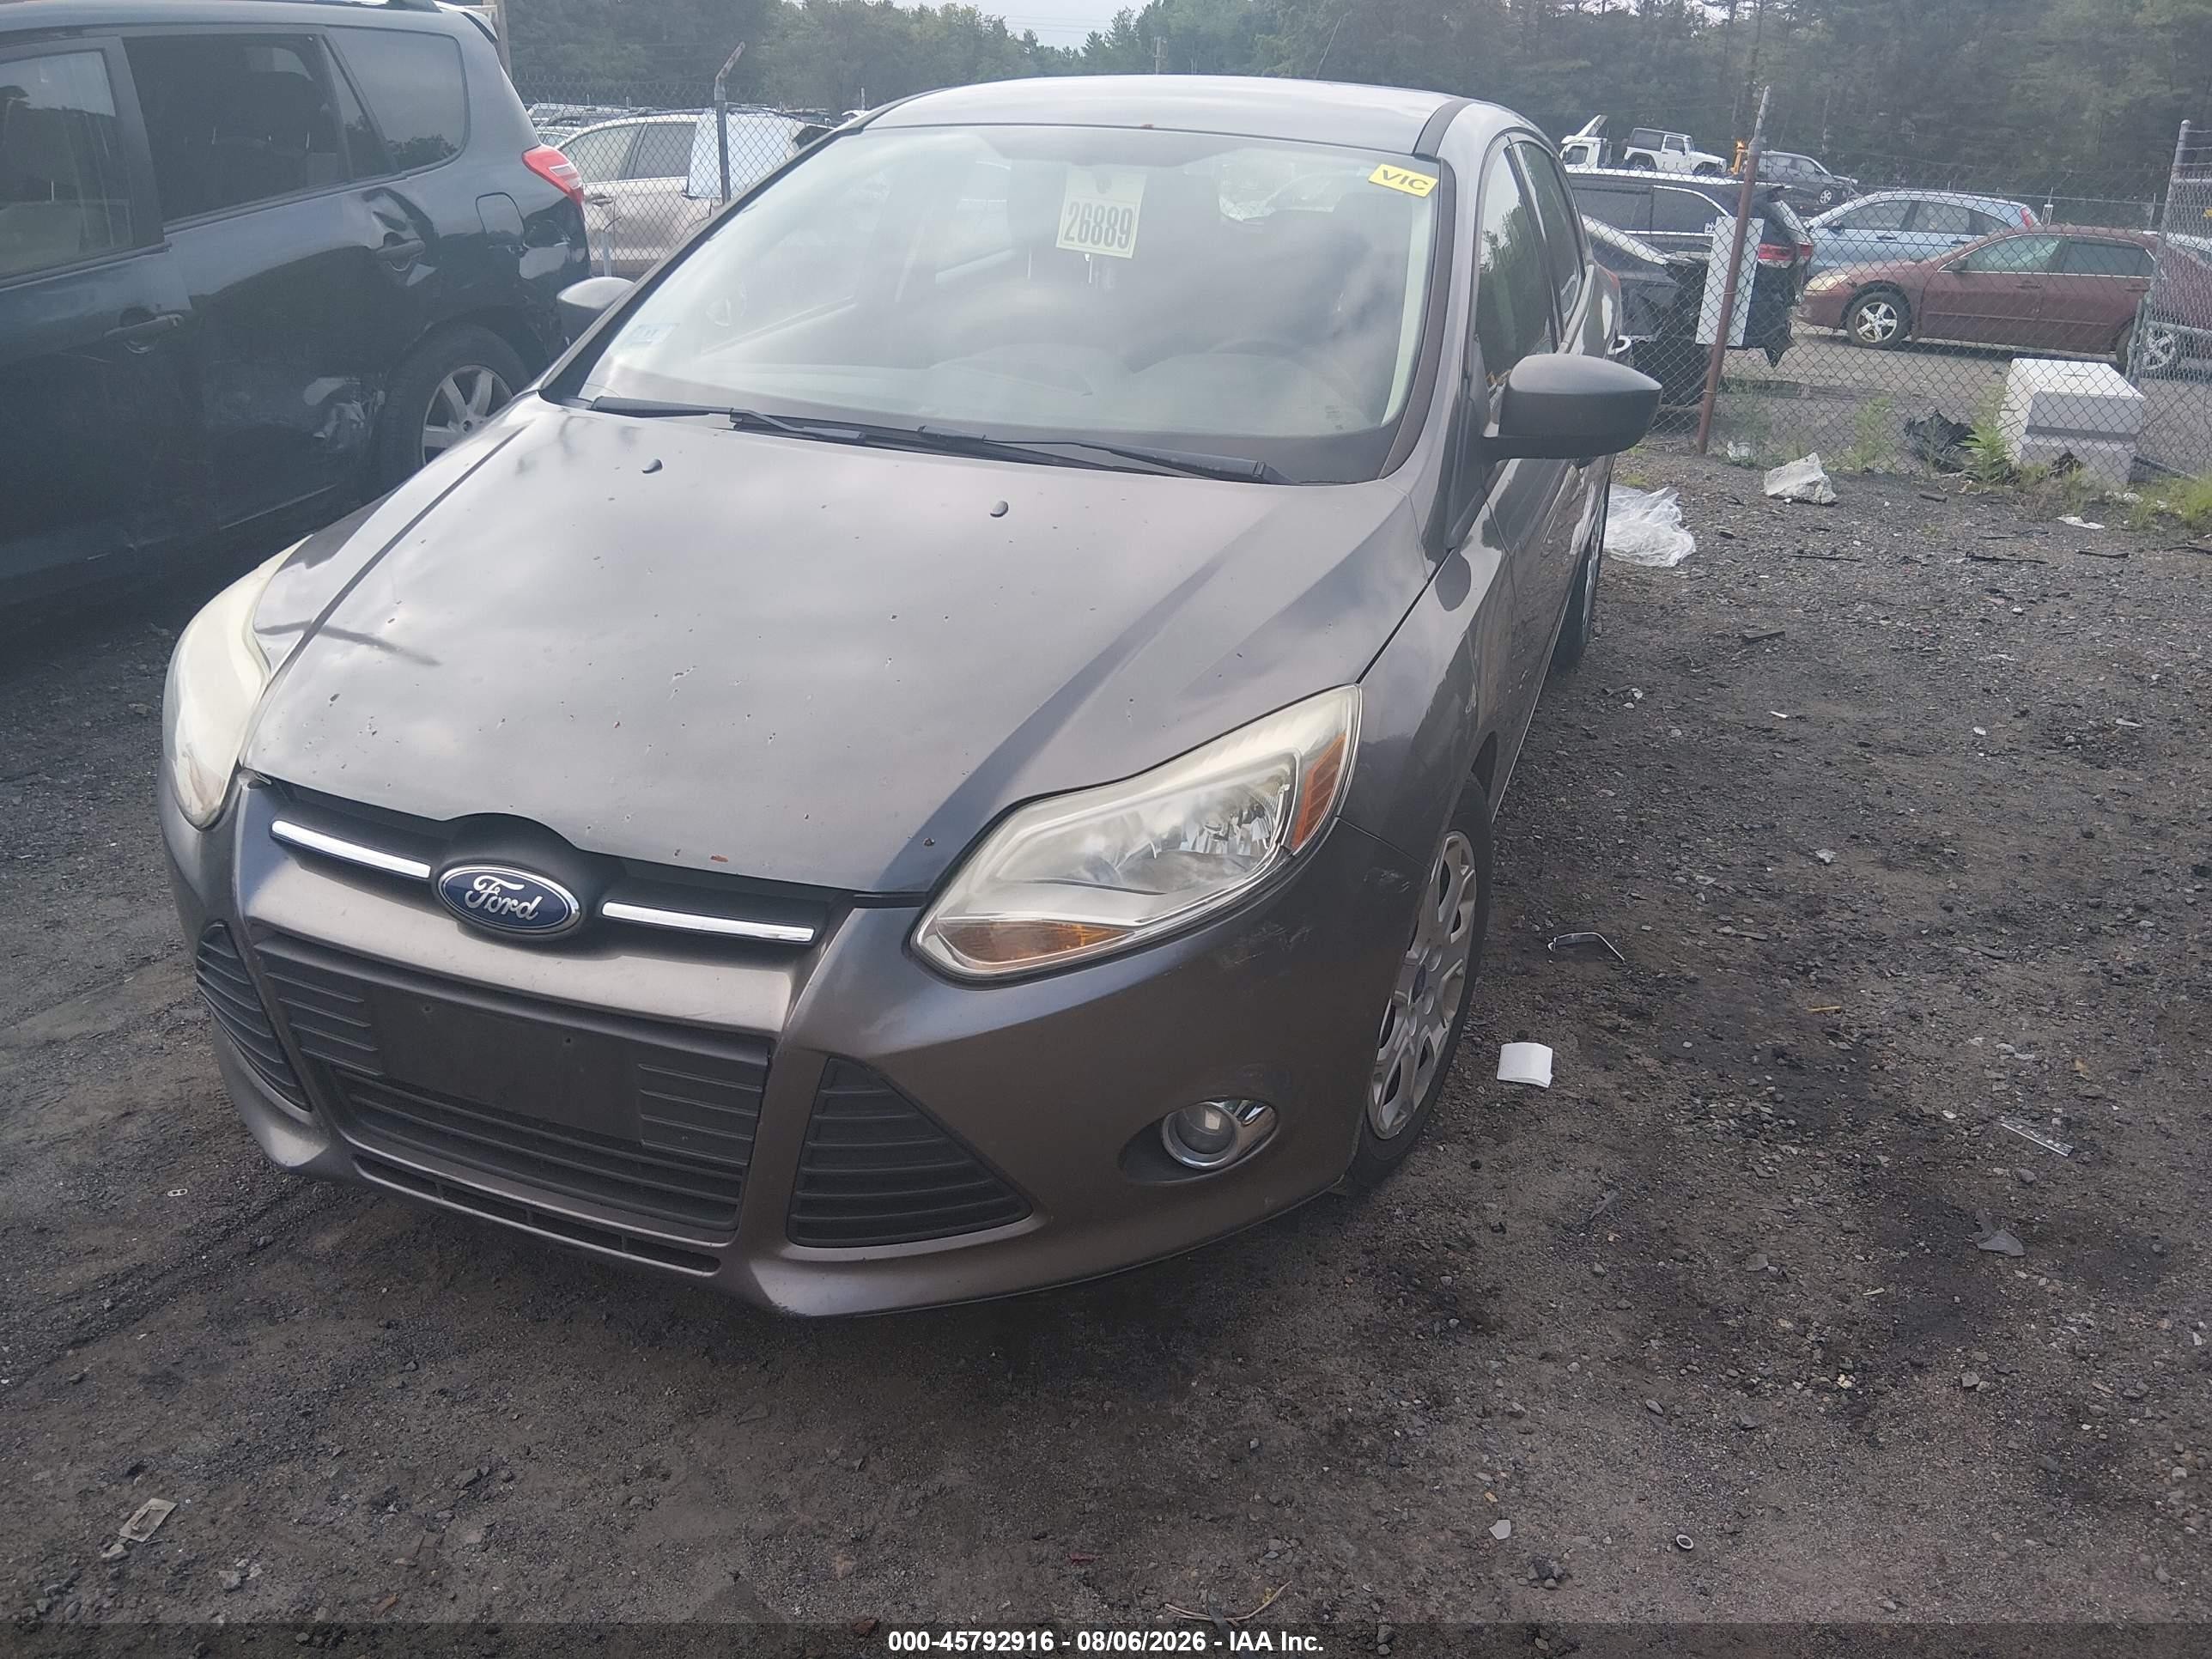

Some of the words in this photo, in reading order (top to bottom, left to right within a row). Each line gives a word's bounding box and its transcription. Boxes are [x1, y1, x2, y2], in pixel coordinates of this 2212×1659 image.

[1382, 168, 1429, 191] VIC
[1064, 201, 1133, 248] 26889
[465, 875, 543, 921] Ford
